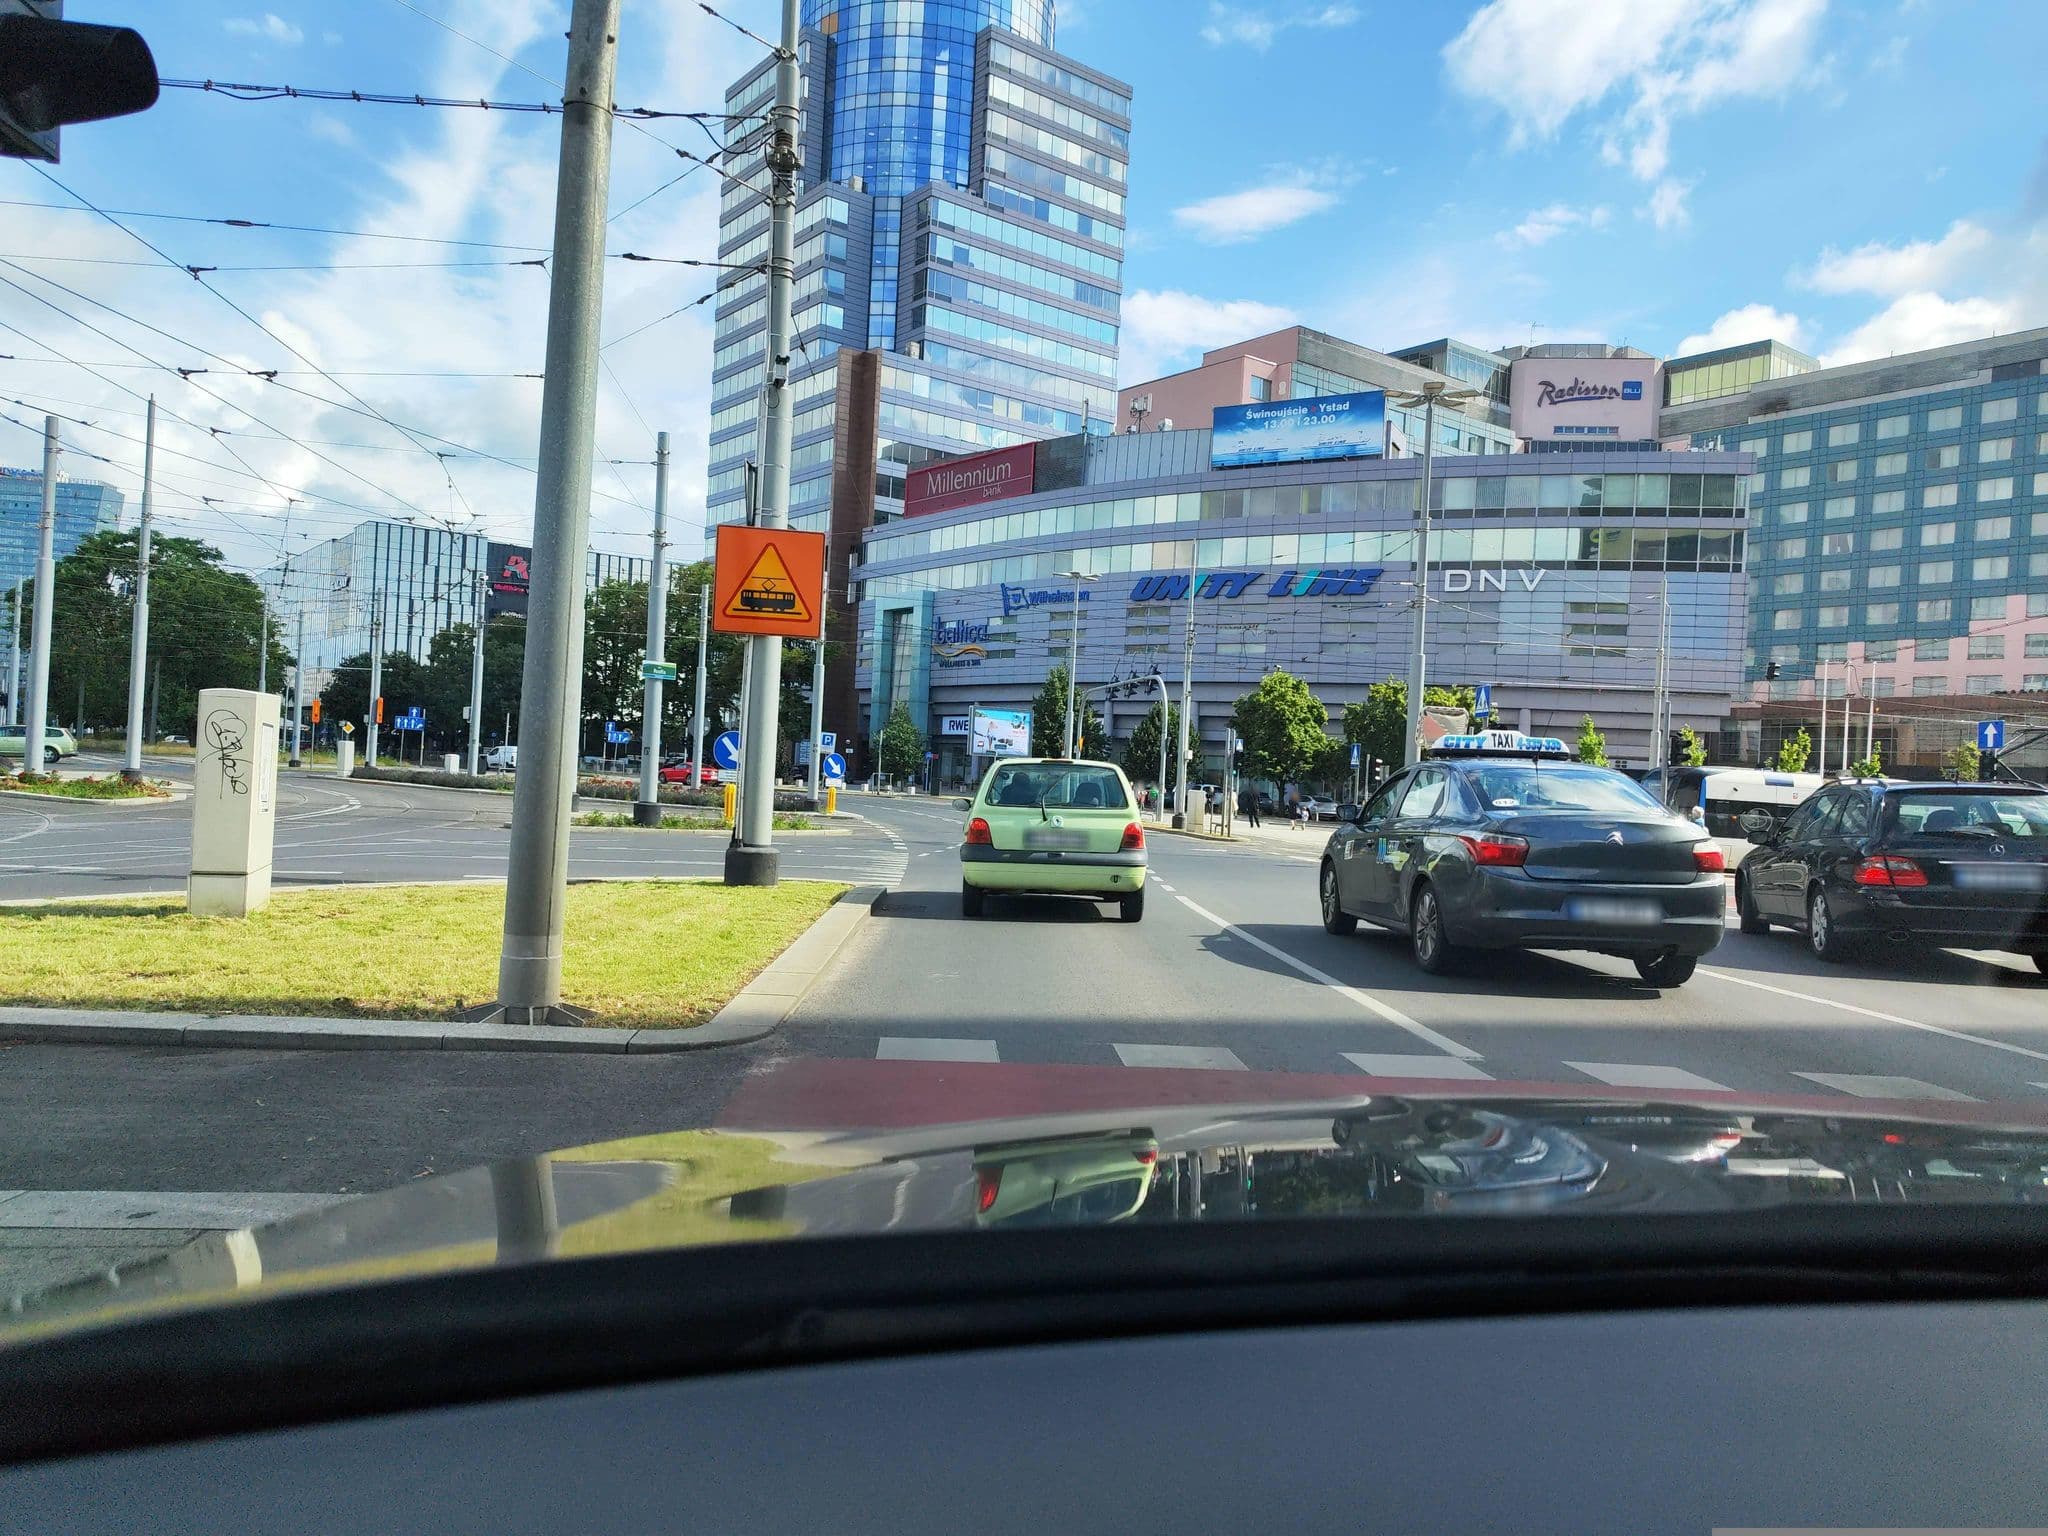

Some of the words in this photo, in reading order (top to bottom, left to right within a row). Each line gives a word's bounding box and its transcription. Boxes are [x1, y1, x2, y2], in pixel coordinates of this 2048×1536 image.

[1537, 377, 1620, 408] Radisson
[1246, 406, 1309, 420] Świnoujście
[1319, 401, 1350, 412] Ystad
[1263, 418, 1295, 429] 13.00
[1303, 414, 1336, 426] 23.00
[926, 462, 1012, 496] Millennium
[982, 483, 1002, 497] bank
[1130, 572, 1266, 601] UNITY
[1267, 568, 1384, 597] LINE
[1444, 568, 1546, 592] DNV
[936, 616, 988, 645] baltica
[949, 719, 969, 731] RWE
[1443, 735, 1488, 749] CITY
[1491, 733, 1514, 748] TAXI
